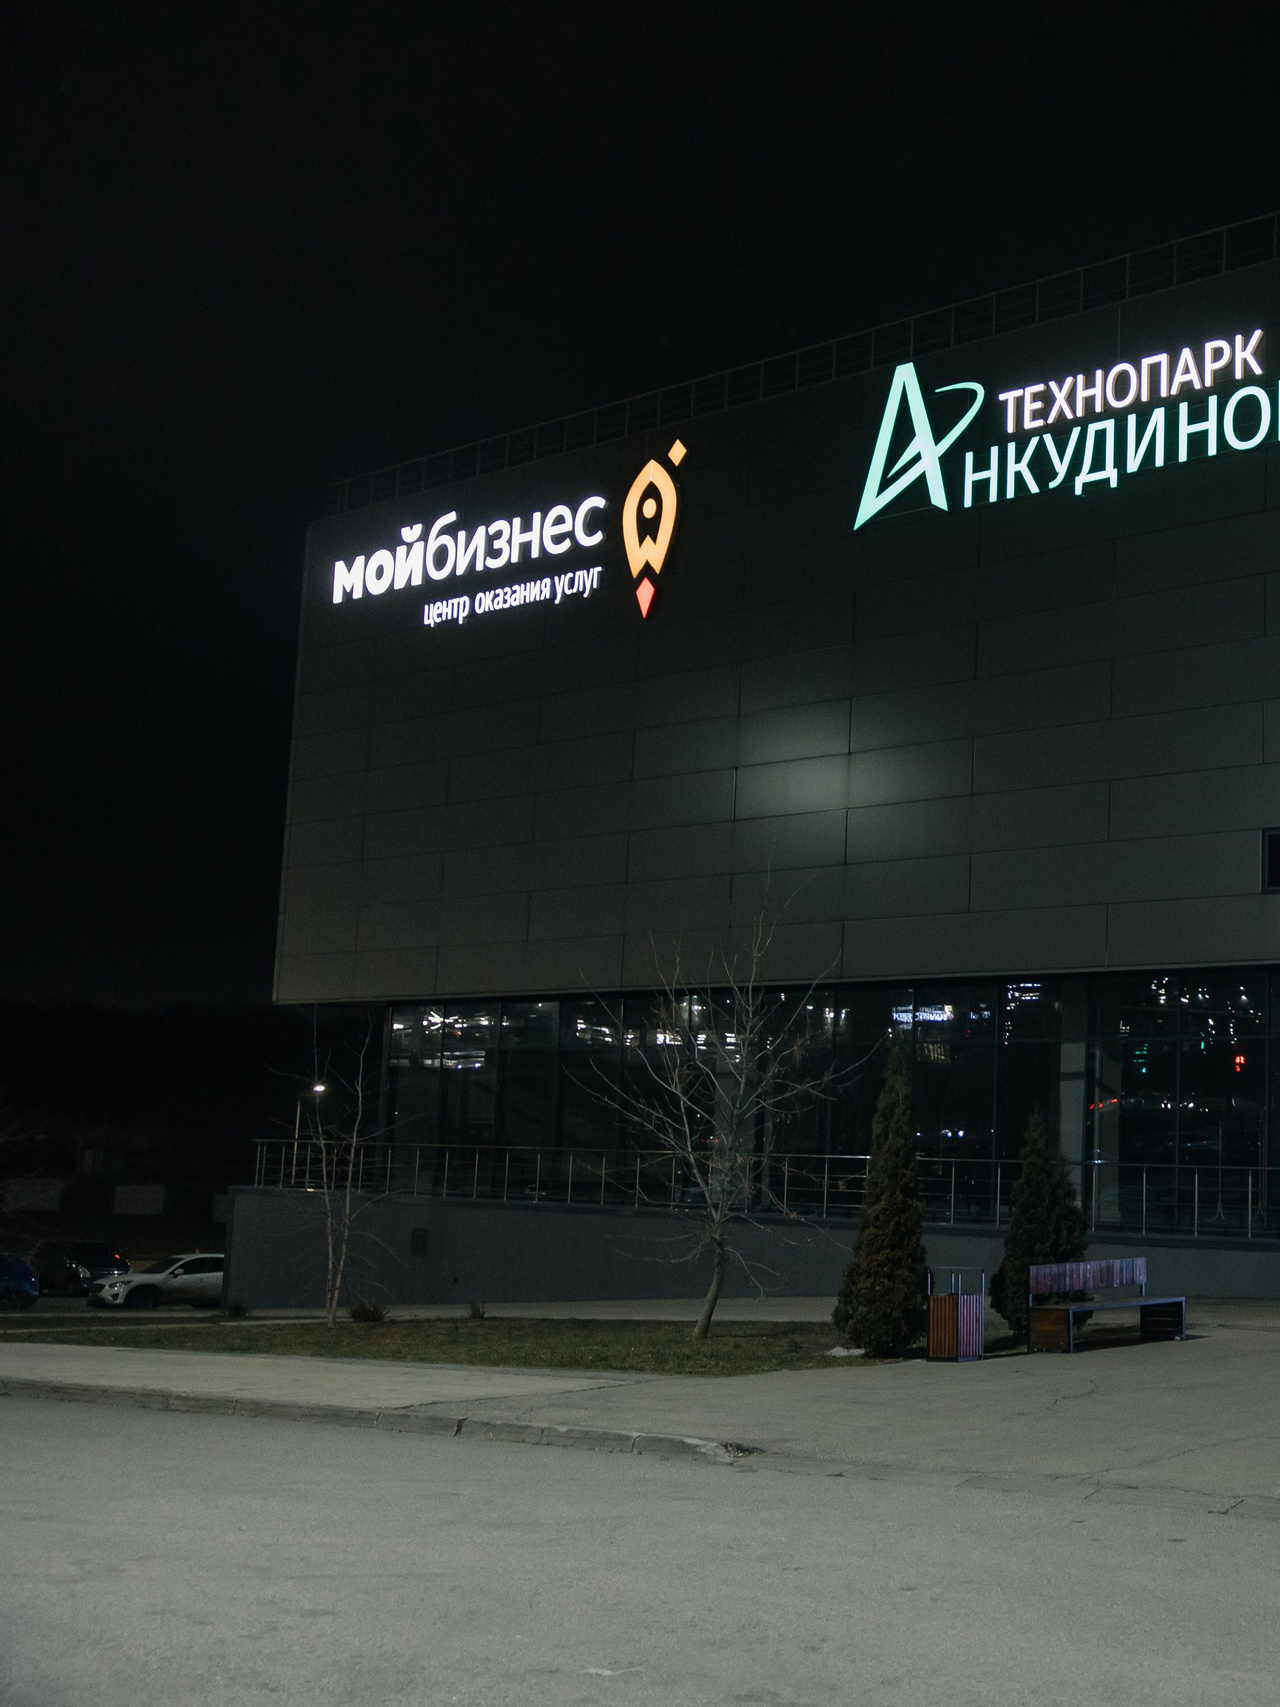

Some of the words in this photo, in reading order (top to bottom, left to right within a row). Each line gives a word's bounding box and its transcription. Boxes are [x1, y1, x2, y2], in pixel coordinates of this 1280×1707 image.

[998, 328, 1264, 434] ТЕХНОПАРК
[423, 595, 471, 628] центр
[474, 577, 552, 614] оказания
[553, 566, 603, 605] услуг
